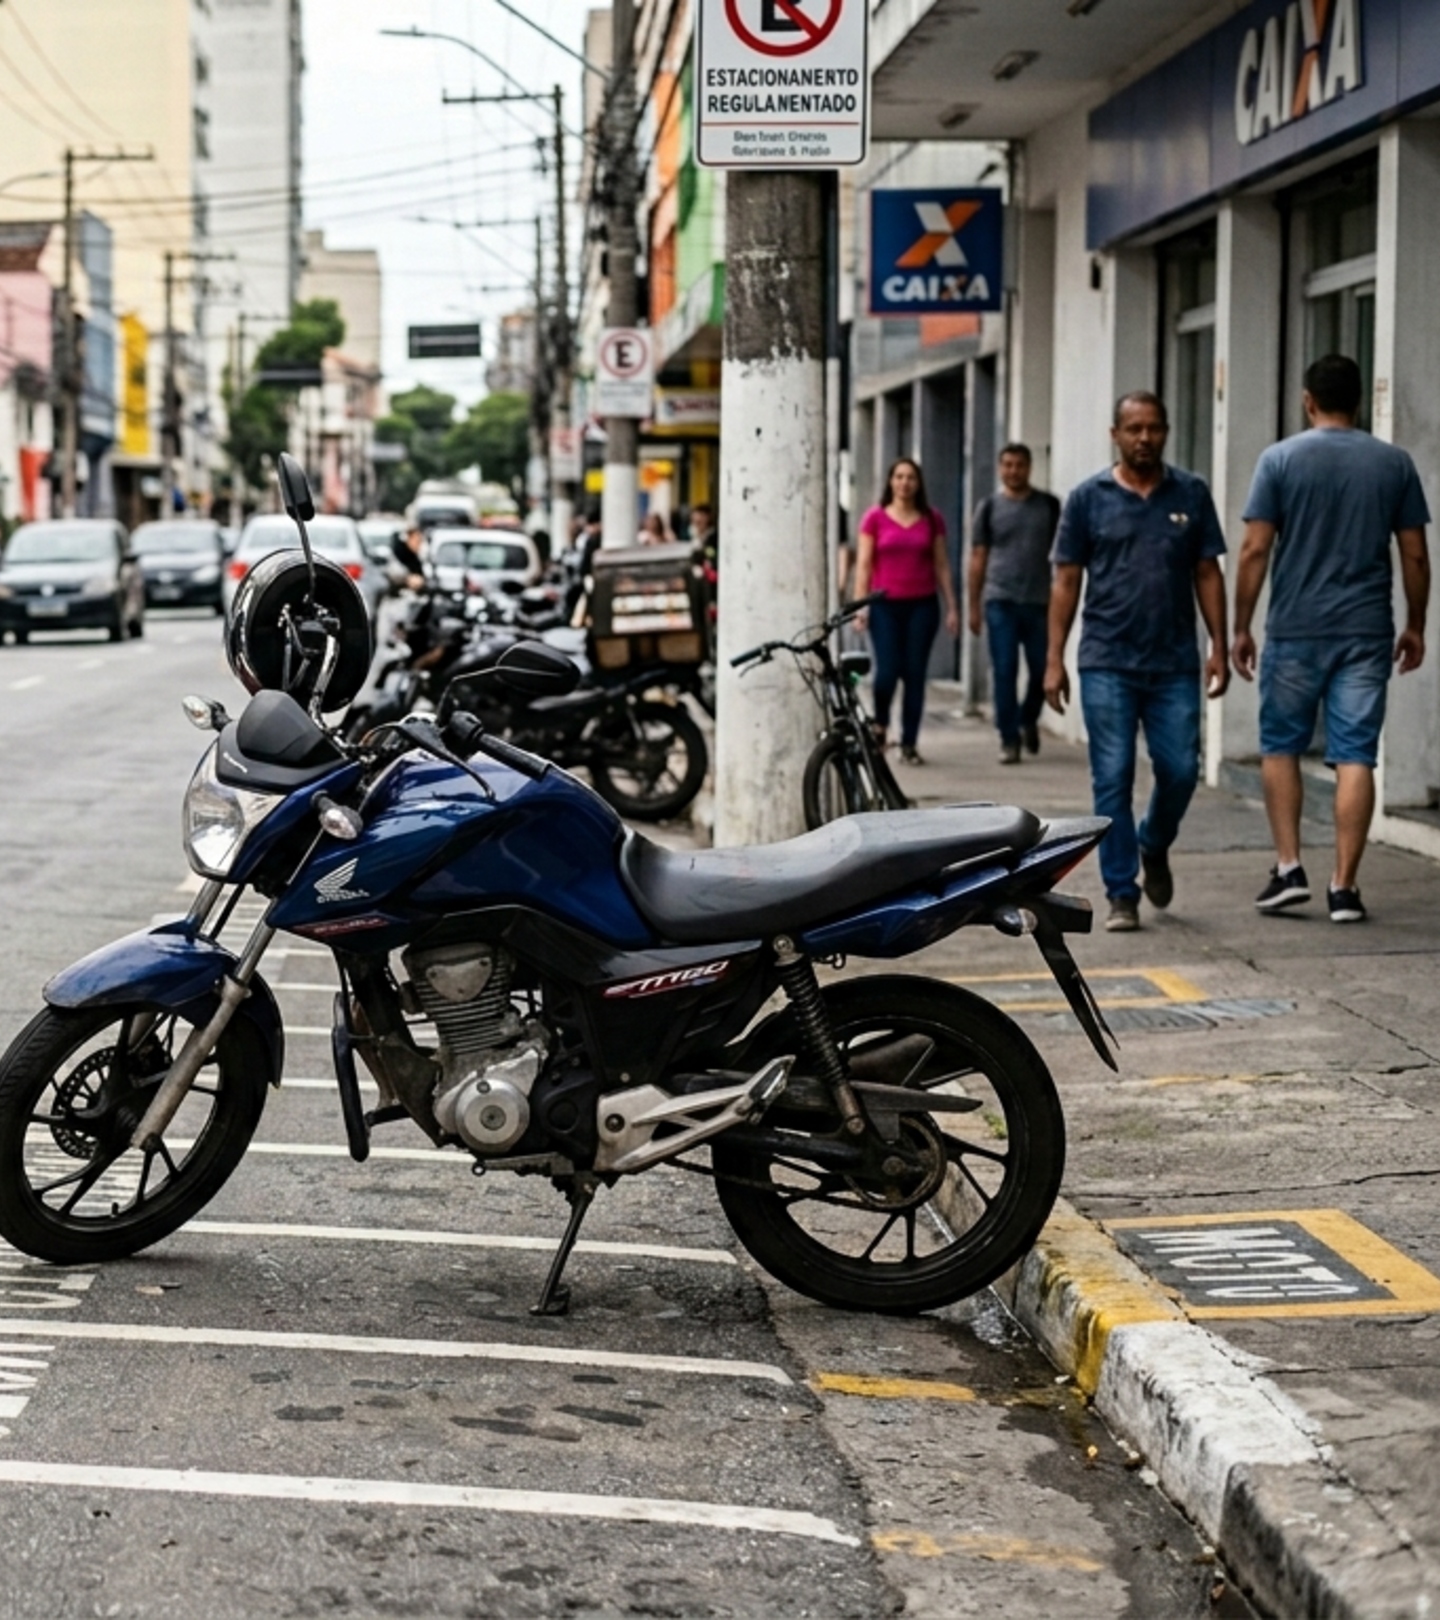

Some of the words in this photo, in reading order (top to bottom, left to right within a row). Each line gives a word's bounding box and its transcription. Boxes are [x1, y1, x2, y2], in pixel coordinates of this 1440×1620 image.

[1234, 0, 1360, 146] CAIXA
[881, 274, 990, 302] CAIXA
[615, 340, 634, 369] E
[1137, 1226, 1359, 1299] MOTO
